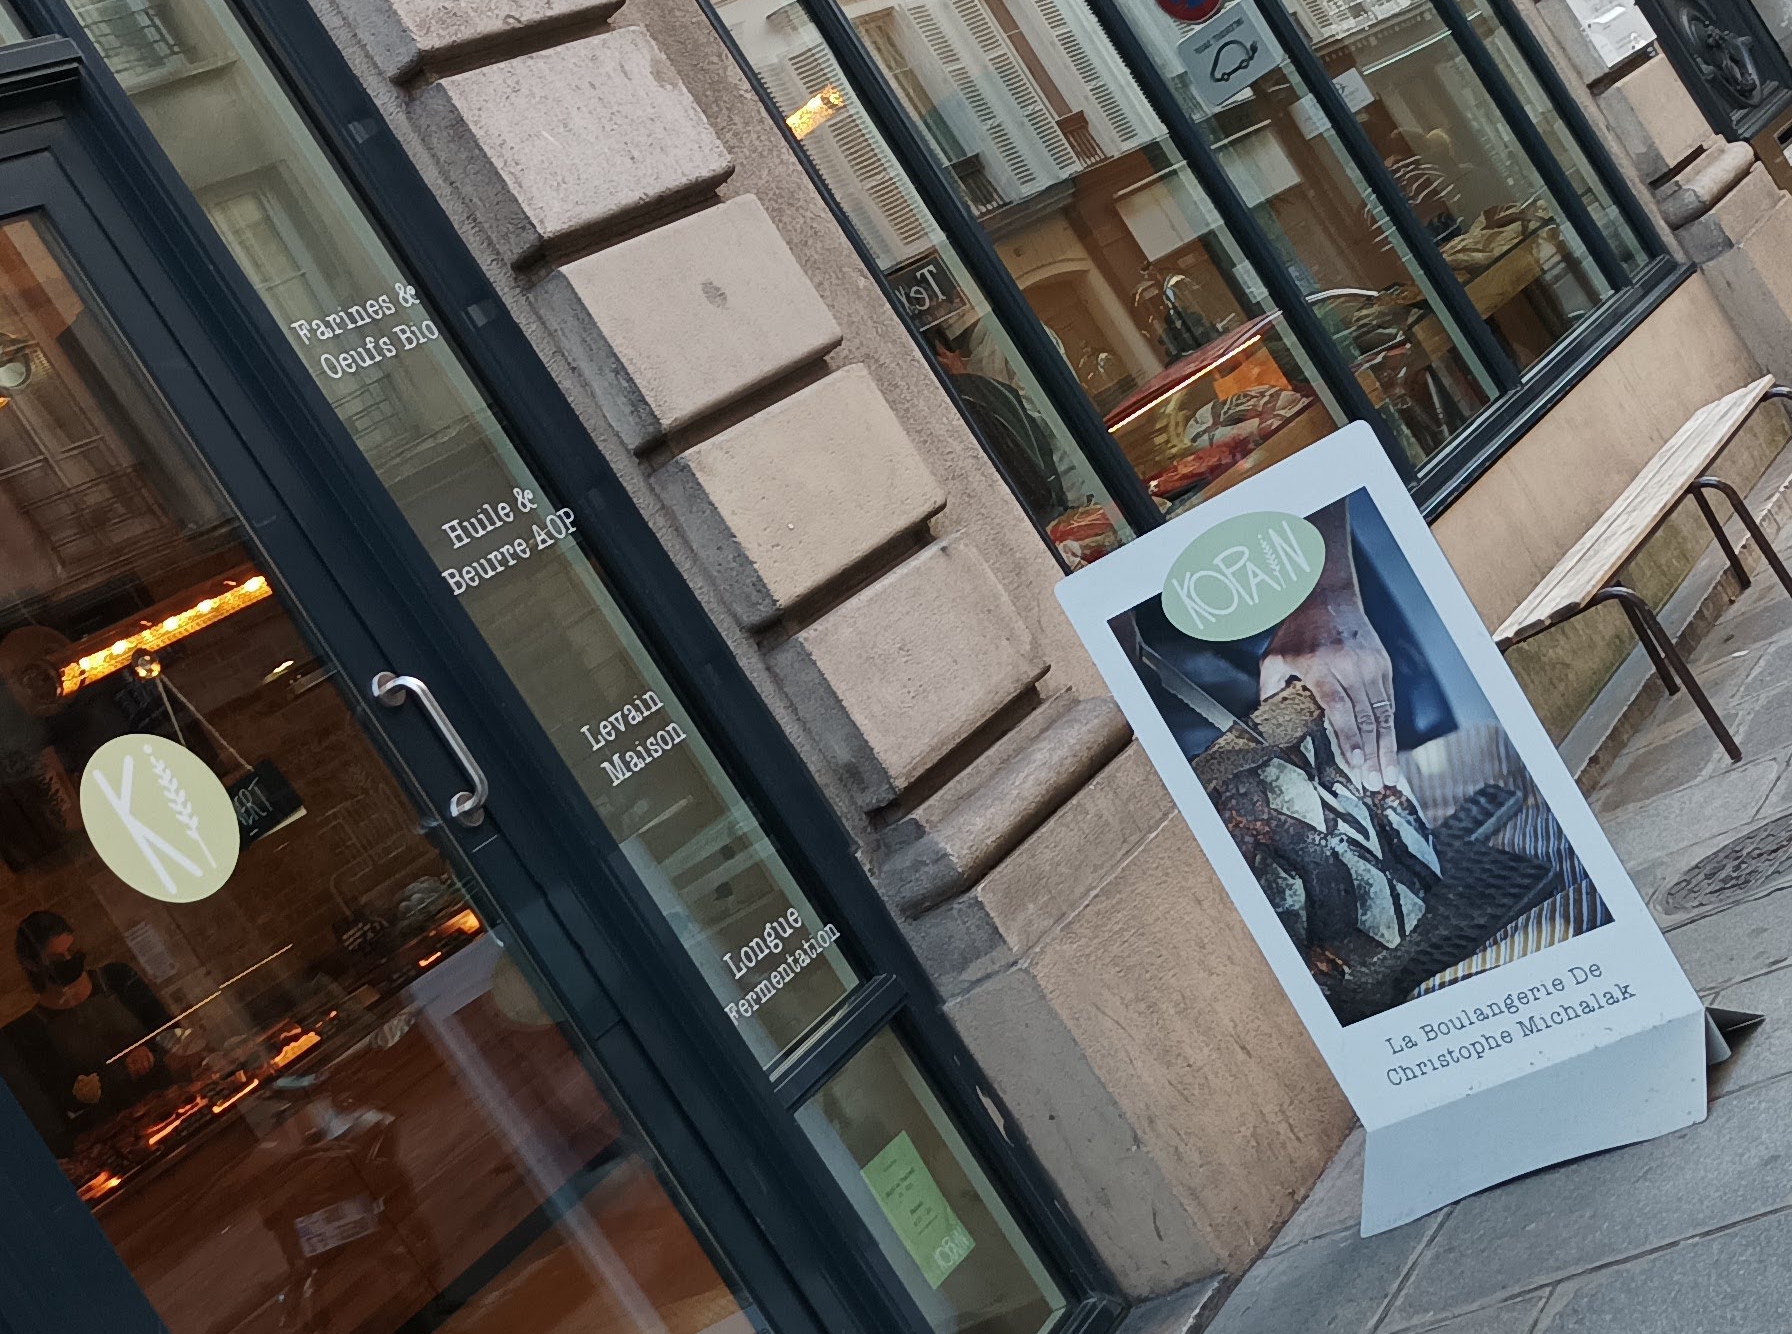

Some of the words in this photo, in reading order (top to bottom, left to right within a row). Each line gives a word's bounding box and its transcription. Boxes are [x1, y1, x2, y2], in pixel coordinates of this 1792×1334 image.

[290, 293, 396, 345] Farines
[394, 282, 420, 307] &
[320, 336, 396, 379] Oeufs
[392, 319, 439, 351] Bio
[441, 500, 514, 549] Huile
[512, 487, 537, 513] &
[441, 538, 530, 595] Beurre
[531, 507, 577, 551] AOP
[1172, 520, 1311, 630] KOPAIN
[580, 689, 664, 752] Levain
[600, 722, 687, 787] Maison
[722, 906, 802, 979] Longue
[723, 922, 841, 1027] Fermentation
[1385, 1035, 1418, 1055] La
[1419, 977, 1565, 1042] Boulangerie
[1568, 963, 1603, 986] De
[1386, 1029, 1514, 1086] Christophe
[1516, 983, 1636, 1038] Michalak
